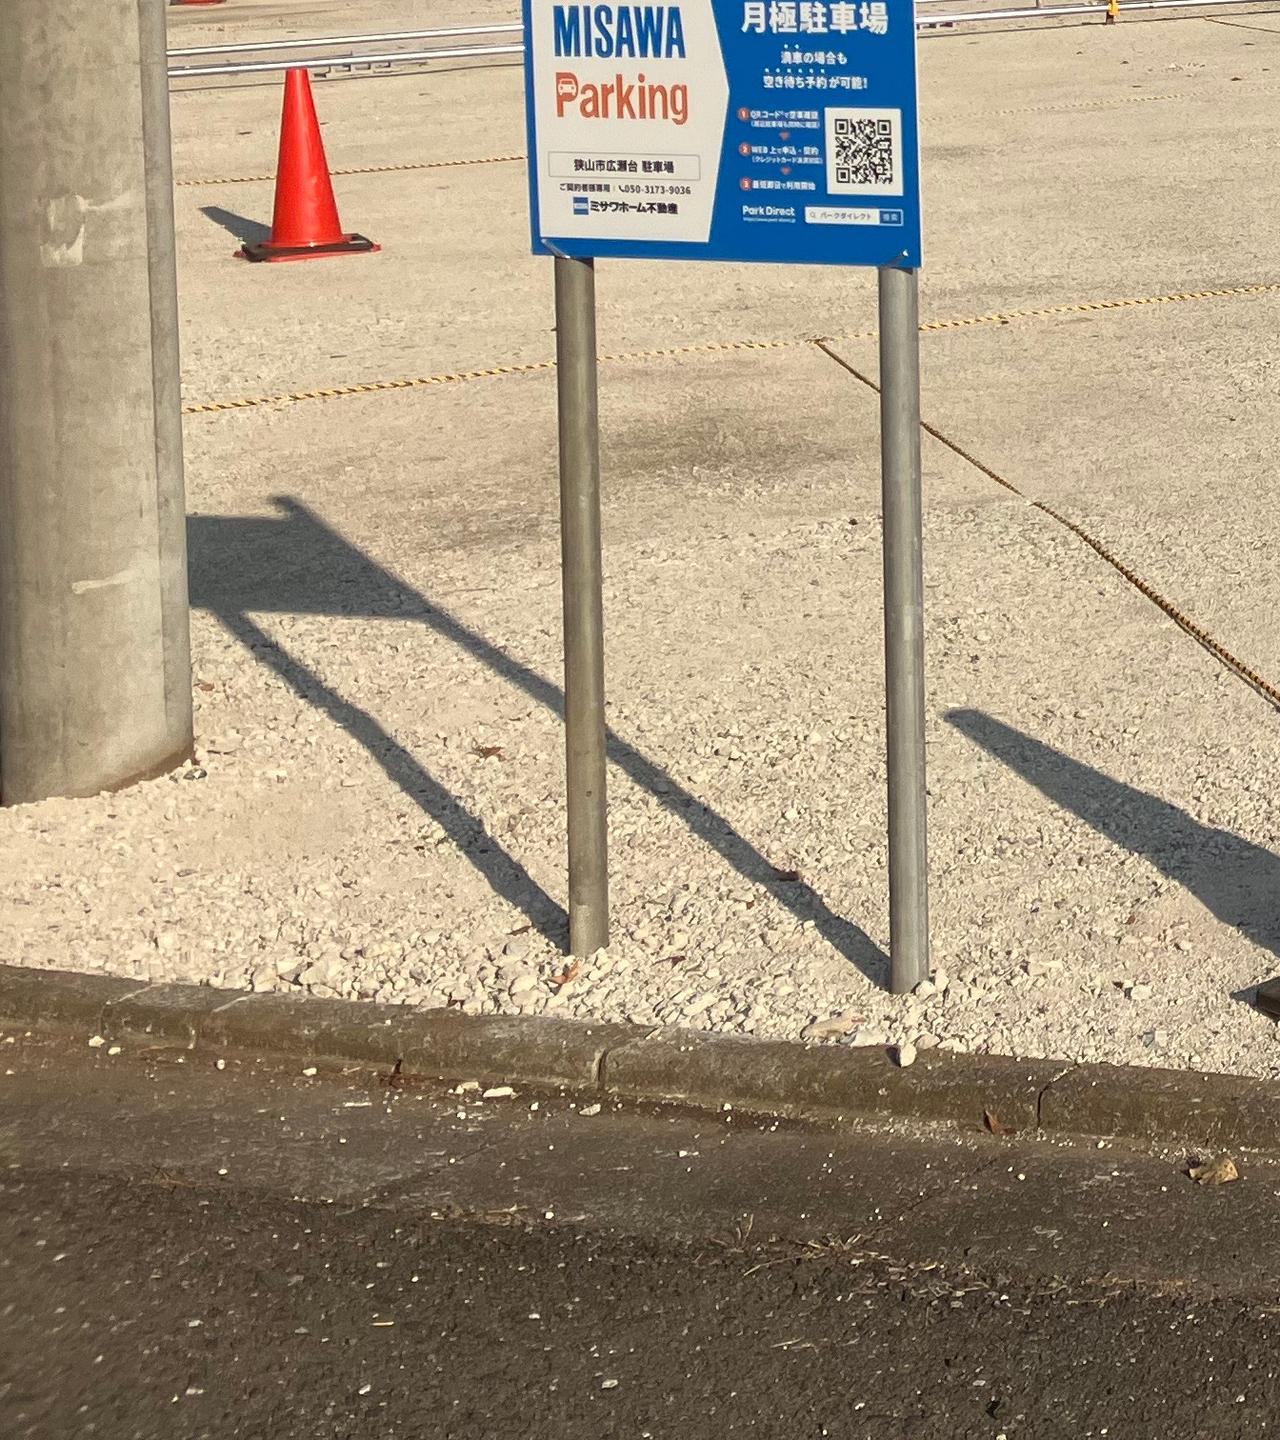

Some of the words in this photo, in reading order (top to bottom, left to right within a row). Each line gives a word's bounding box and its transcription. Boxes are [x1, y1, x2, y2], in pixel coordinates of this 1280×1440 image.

[741, 1, 889, 35] 月極駐車場
[552, 4, 687, 58] MISAWA
[555, 72, 689, 125] Parking
[573, 158, 638, 173] 狭山市広瀬台
[641, 160, 675, 174] 駐車場
[590, 200, 679, 215] ミサワホーム不動産
[742, 205, 765, 216] Park
[766, 206, 795, 217] Direct
